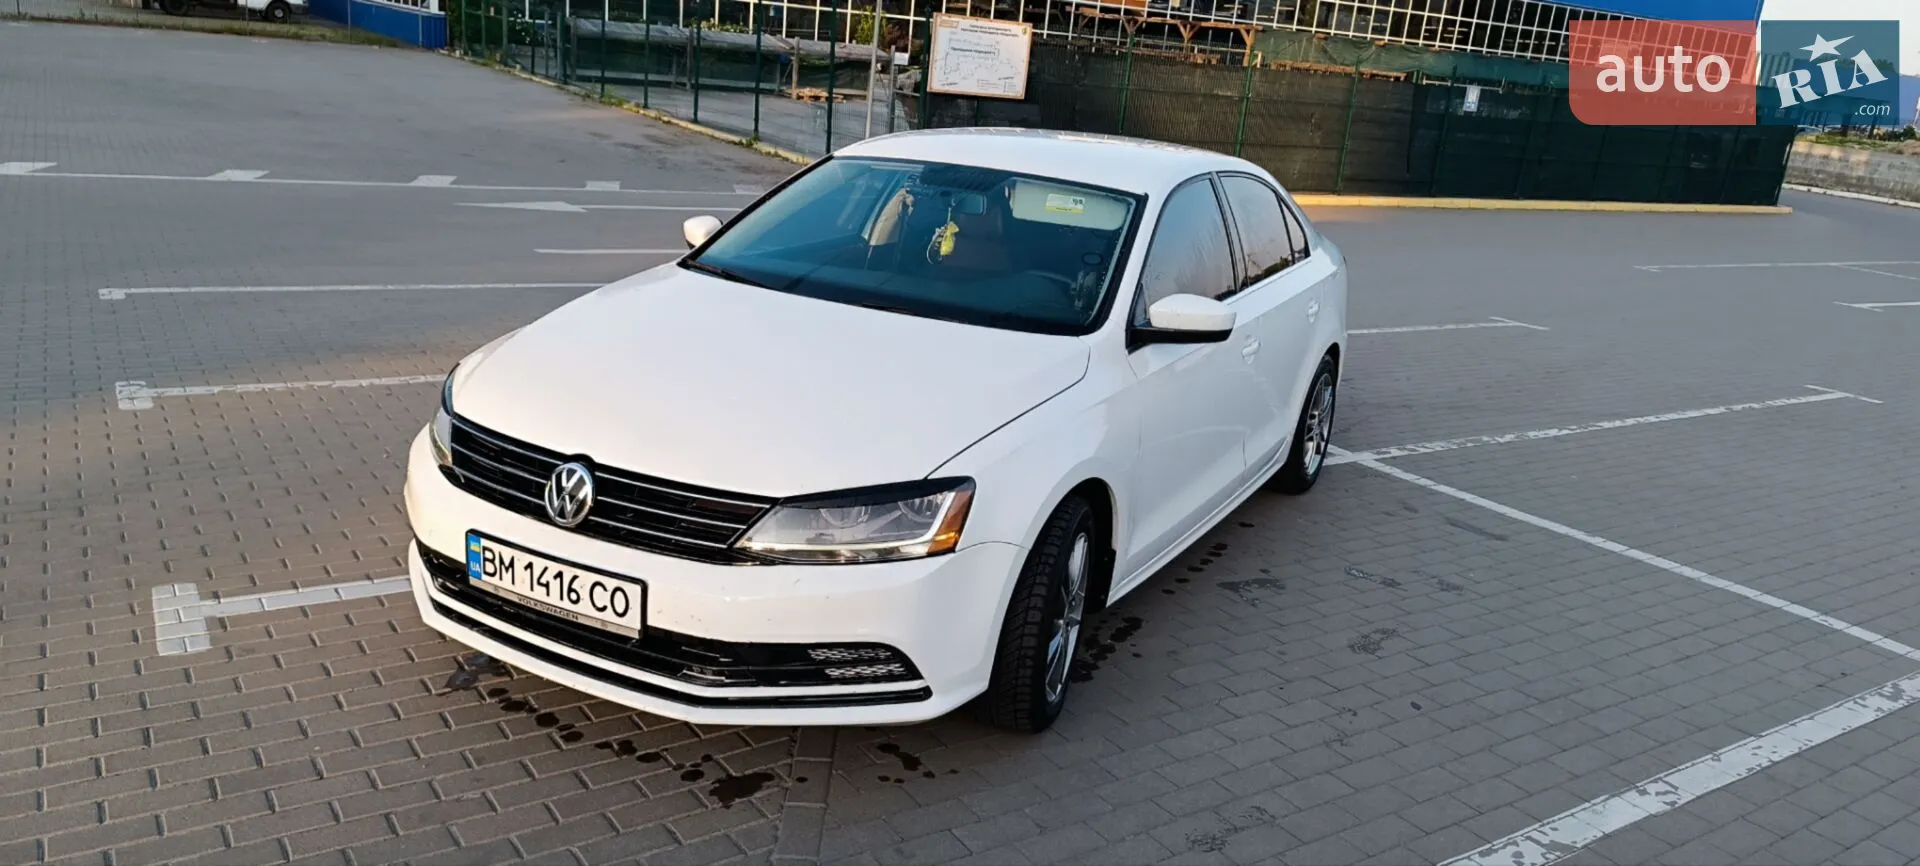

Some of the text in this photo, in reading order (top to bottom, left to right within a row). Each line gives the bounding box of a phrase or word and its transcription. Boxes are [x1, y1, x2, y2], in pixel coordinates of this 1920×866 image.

[470, 561, 481, 573] UA
[482, 546, 630, 618] BM 1416 CO
